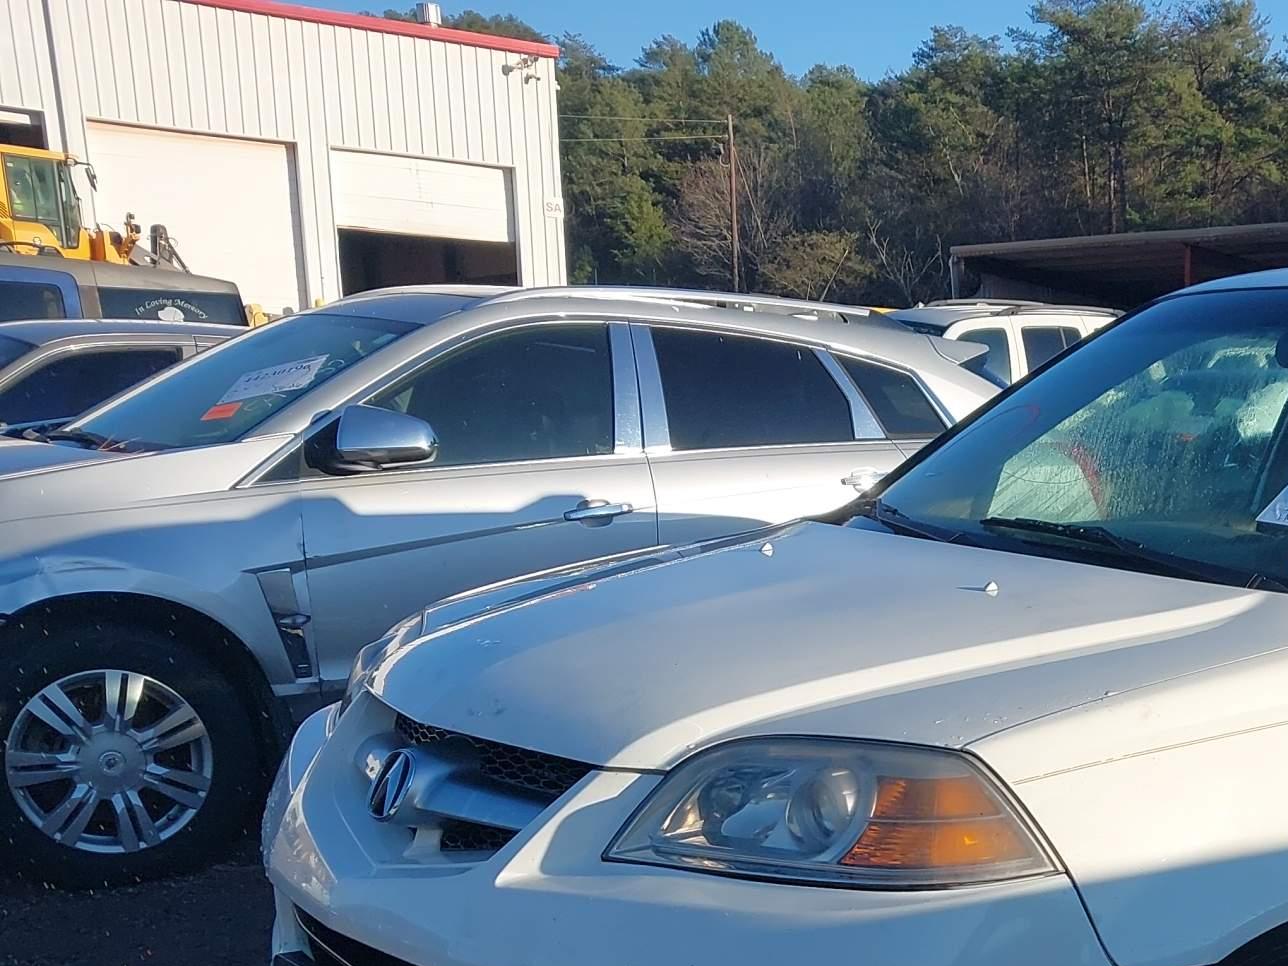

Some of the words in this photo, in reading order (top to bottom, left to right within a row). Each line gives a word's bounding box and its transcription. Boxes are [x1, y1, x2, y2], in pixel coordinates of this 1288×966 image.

[135, 306, 145, 316] In
[145, 297, 173, 309] Loving
[174, 298, 208, 319] Memory
